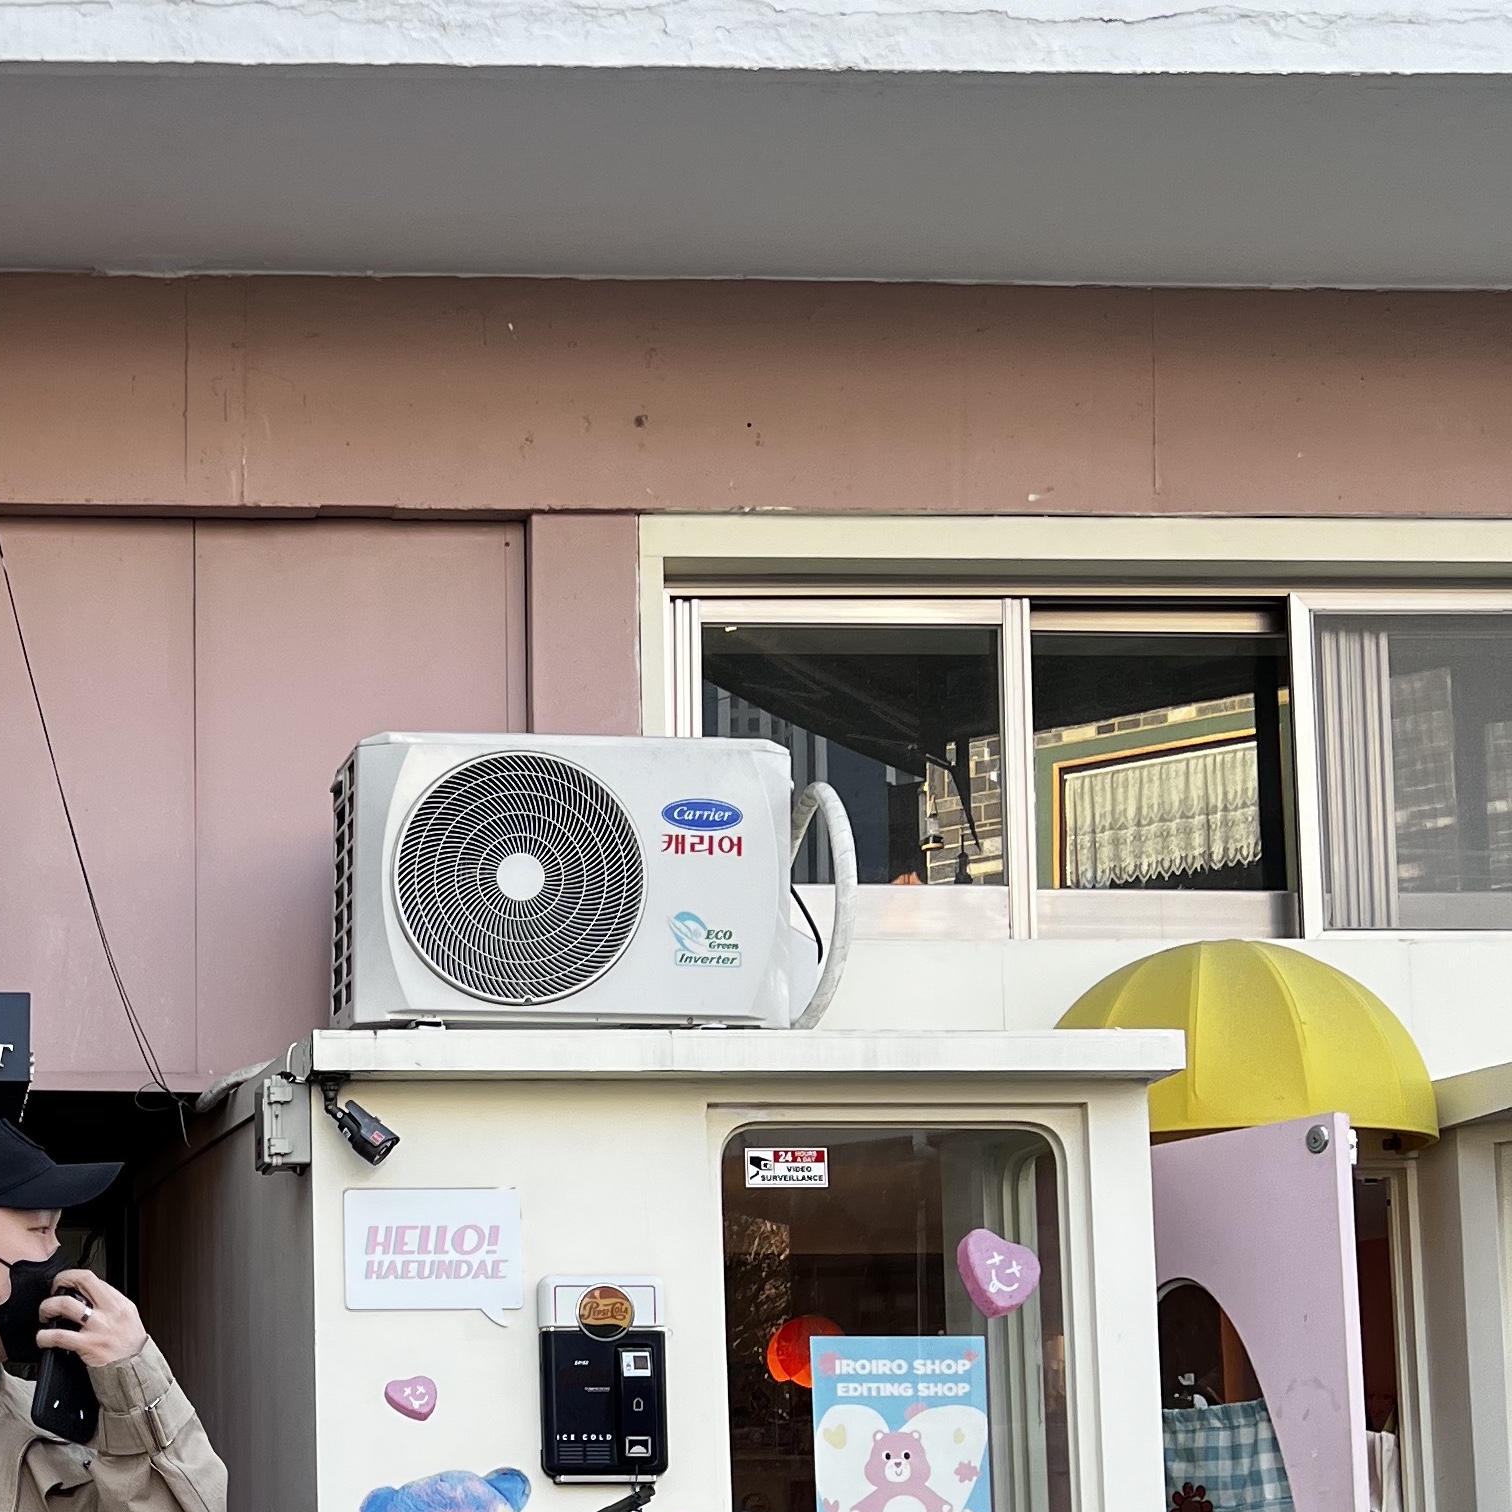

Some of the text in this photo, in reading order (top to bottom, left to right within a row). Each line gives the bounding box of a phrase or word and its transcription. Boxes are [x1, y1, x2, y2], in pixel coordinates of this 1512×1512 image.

[673, 806, 733, 822] Carrier
[661, 833, 743, 857] 캐리어
[705, 929, 733, 941] ECO
[708, 940, 740, 951] Green
[679, 953, 738, 966] Inverter
[778, 1151, 793, 1163] 24
[786, 1165, 812, 1173] VIDEO
[760, 1174, 824, 1182] SURVEILLANCE
[365, 1224, 501, 1256] HELLO!
[364, 1259, 509, 1280] HAEUNDAE
[835, 1359, 971, 1375] IROIRO SHOP
[836, 1382, 971, 1397] EDITING SHOP
[556, 1433, 613, 1441] ICE COLD
